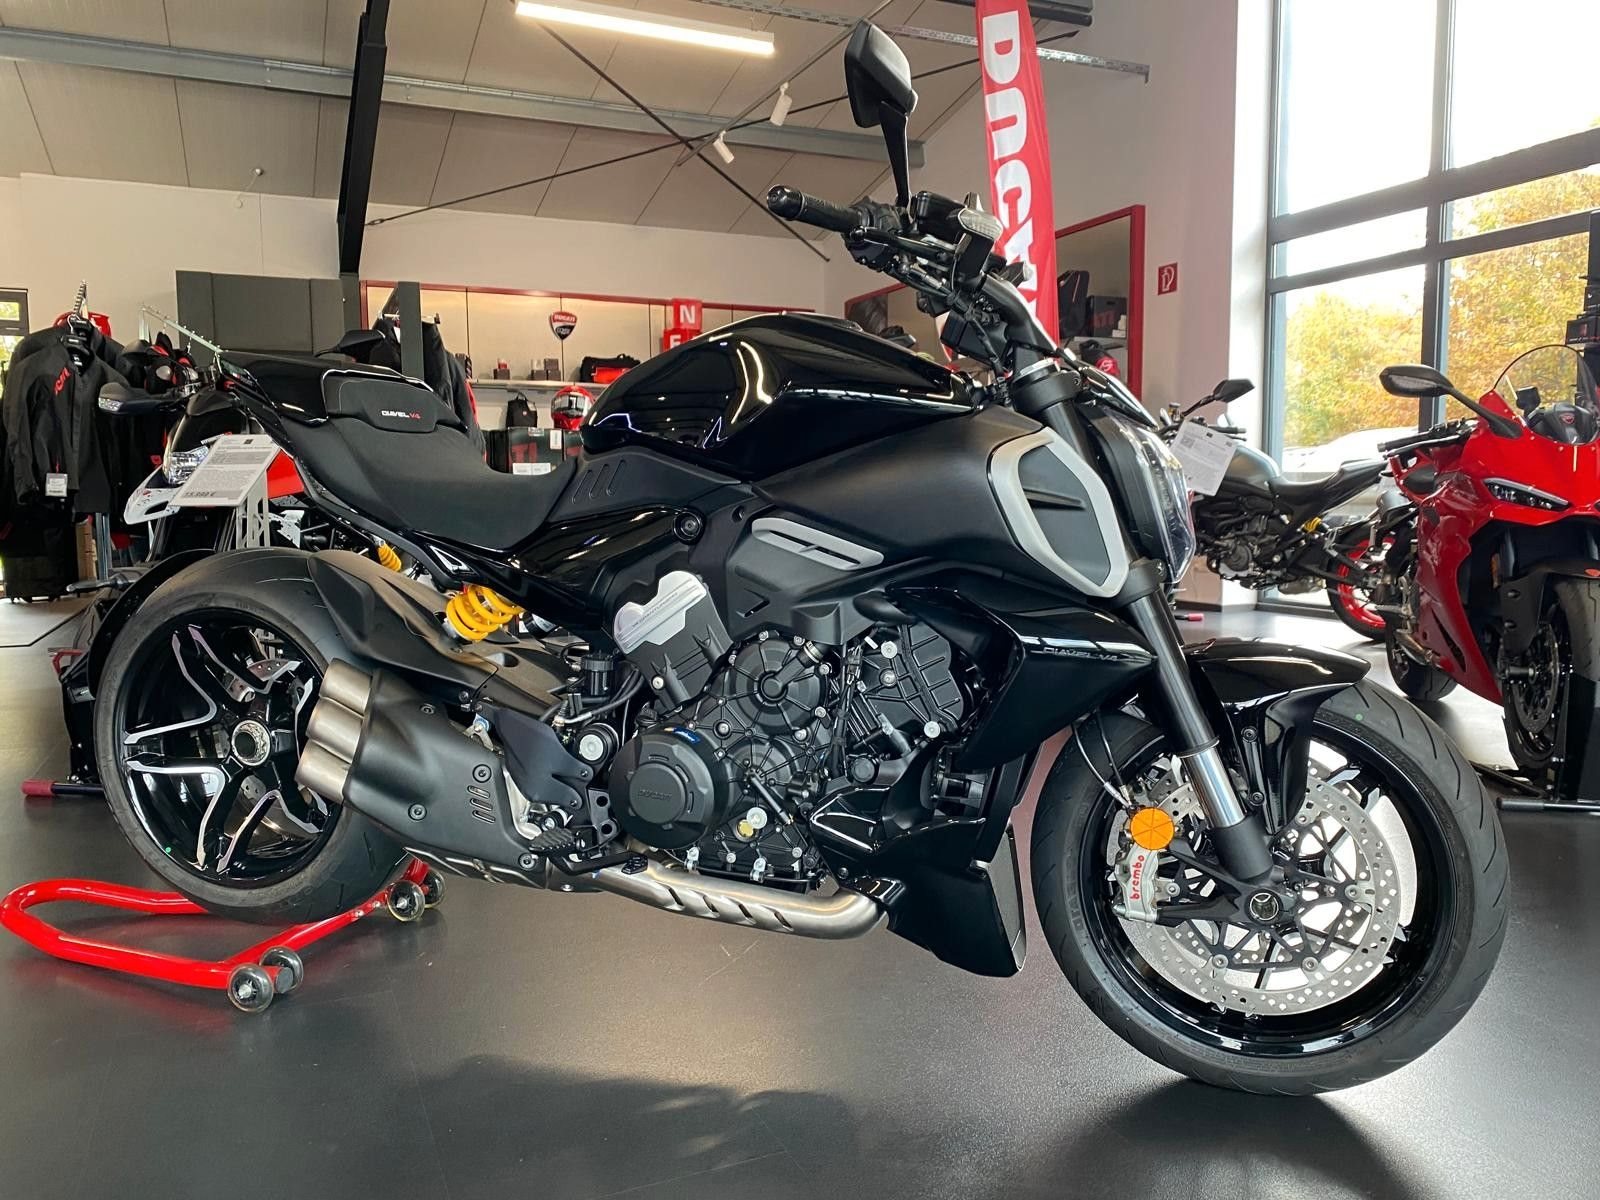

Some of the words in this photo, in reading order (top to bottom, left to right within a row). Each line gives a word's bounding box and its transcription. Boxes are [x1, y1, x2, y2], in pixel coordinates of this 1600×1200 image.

[981, 9, 1038, 323] DUCA
[680, 305, 696, 324] N
[1043, 646, 1097, 660] DIAVEL
[1099, 654, 1119, 662] V4
[1130, 854, 1145, 900] brembo
